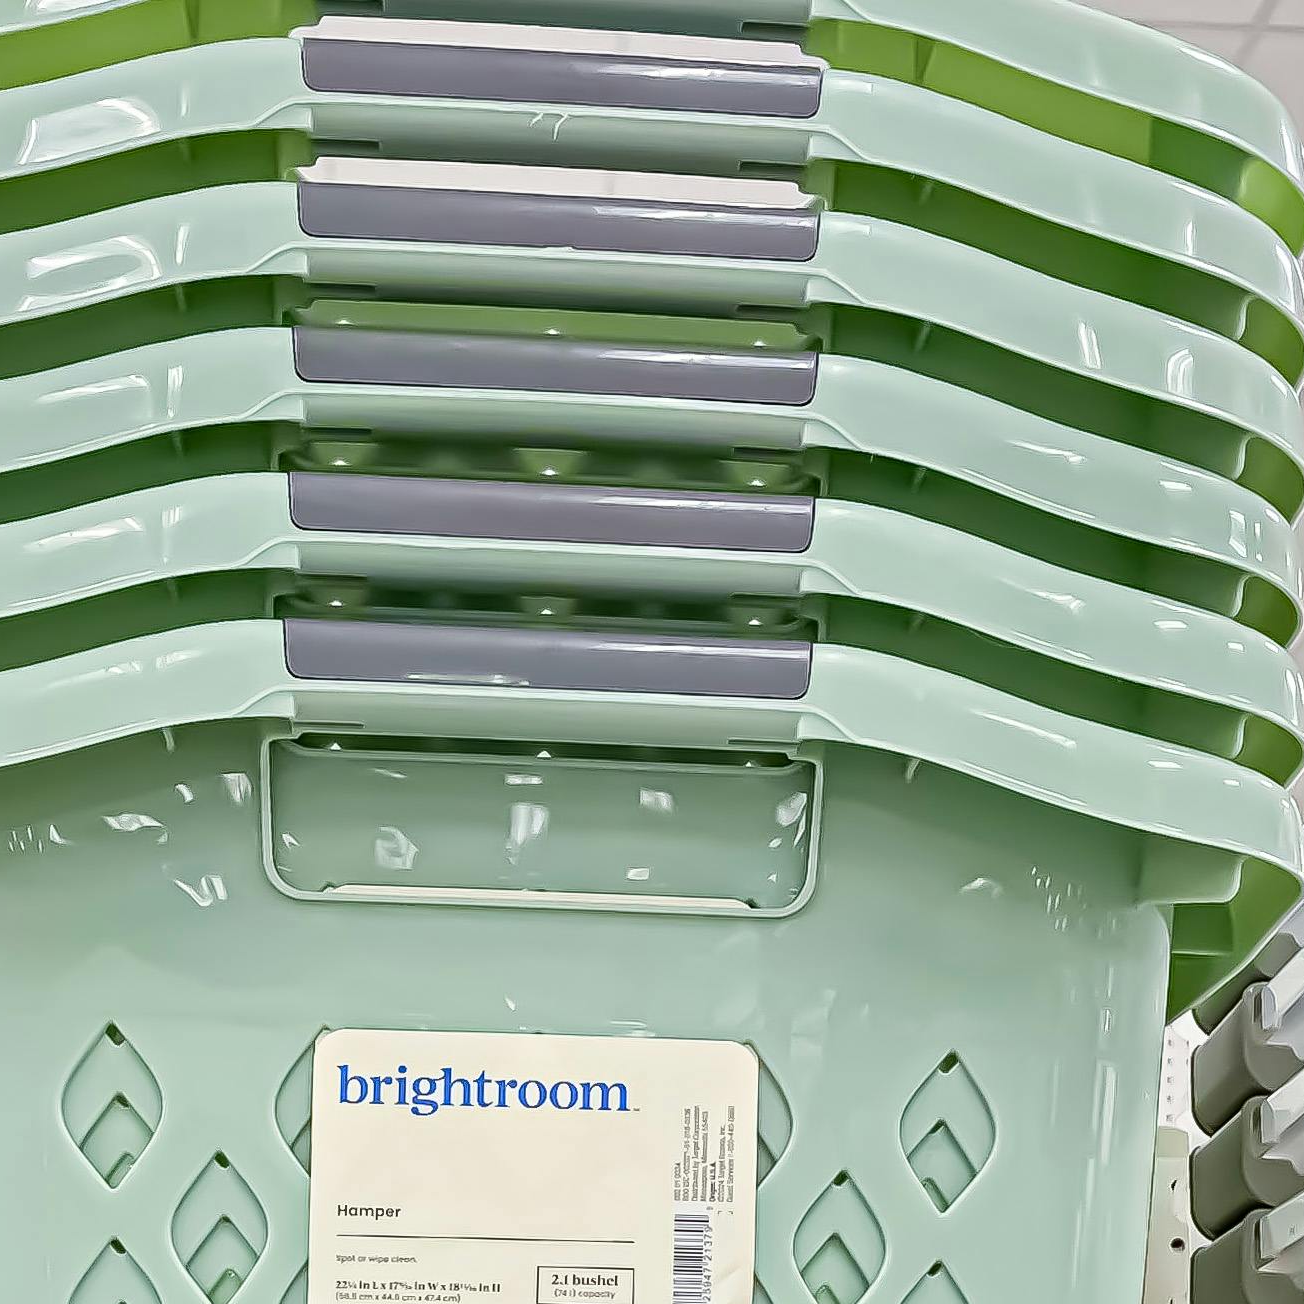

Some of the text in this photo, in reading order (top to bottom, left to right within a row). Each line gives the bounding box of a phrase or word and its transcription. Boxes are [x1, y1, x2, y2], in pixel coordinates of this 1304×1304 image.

[337, 1064, 631, 1116] brightroom
[337, 1204, 402, 1221] Hamper
[572, 1274, 619, 1286] bushel
